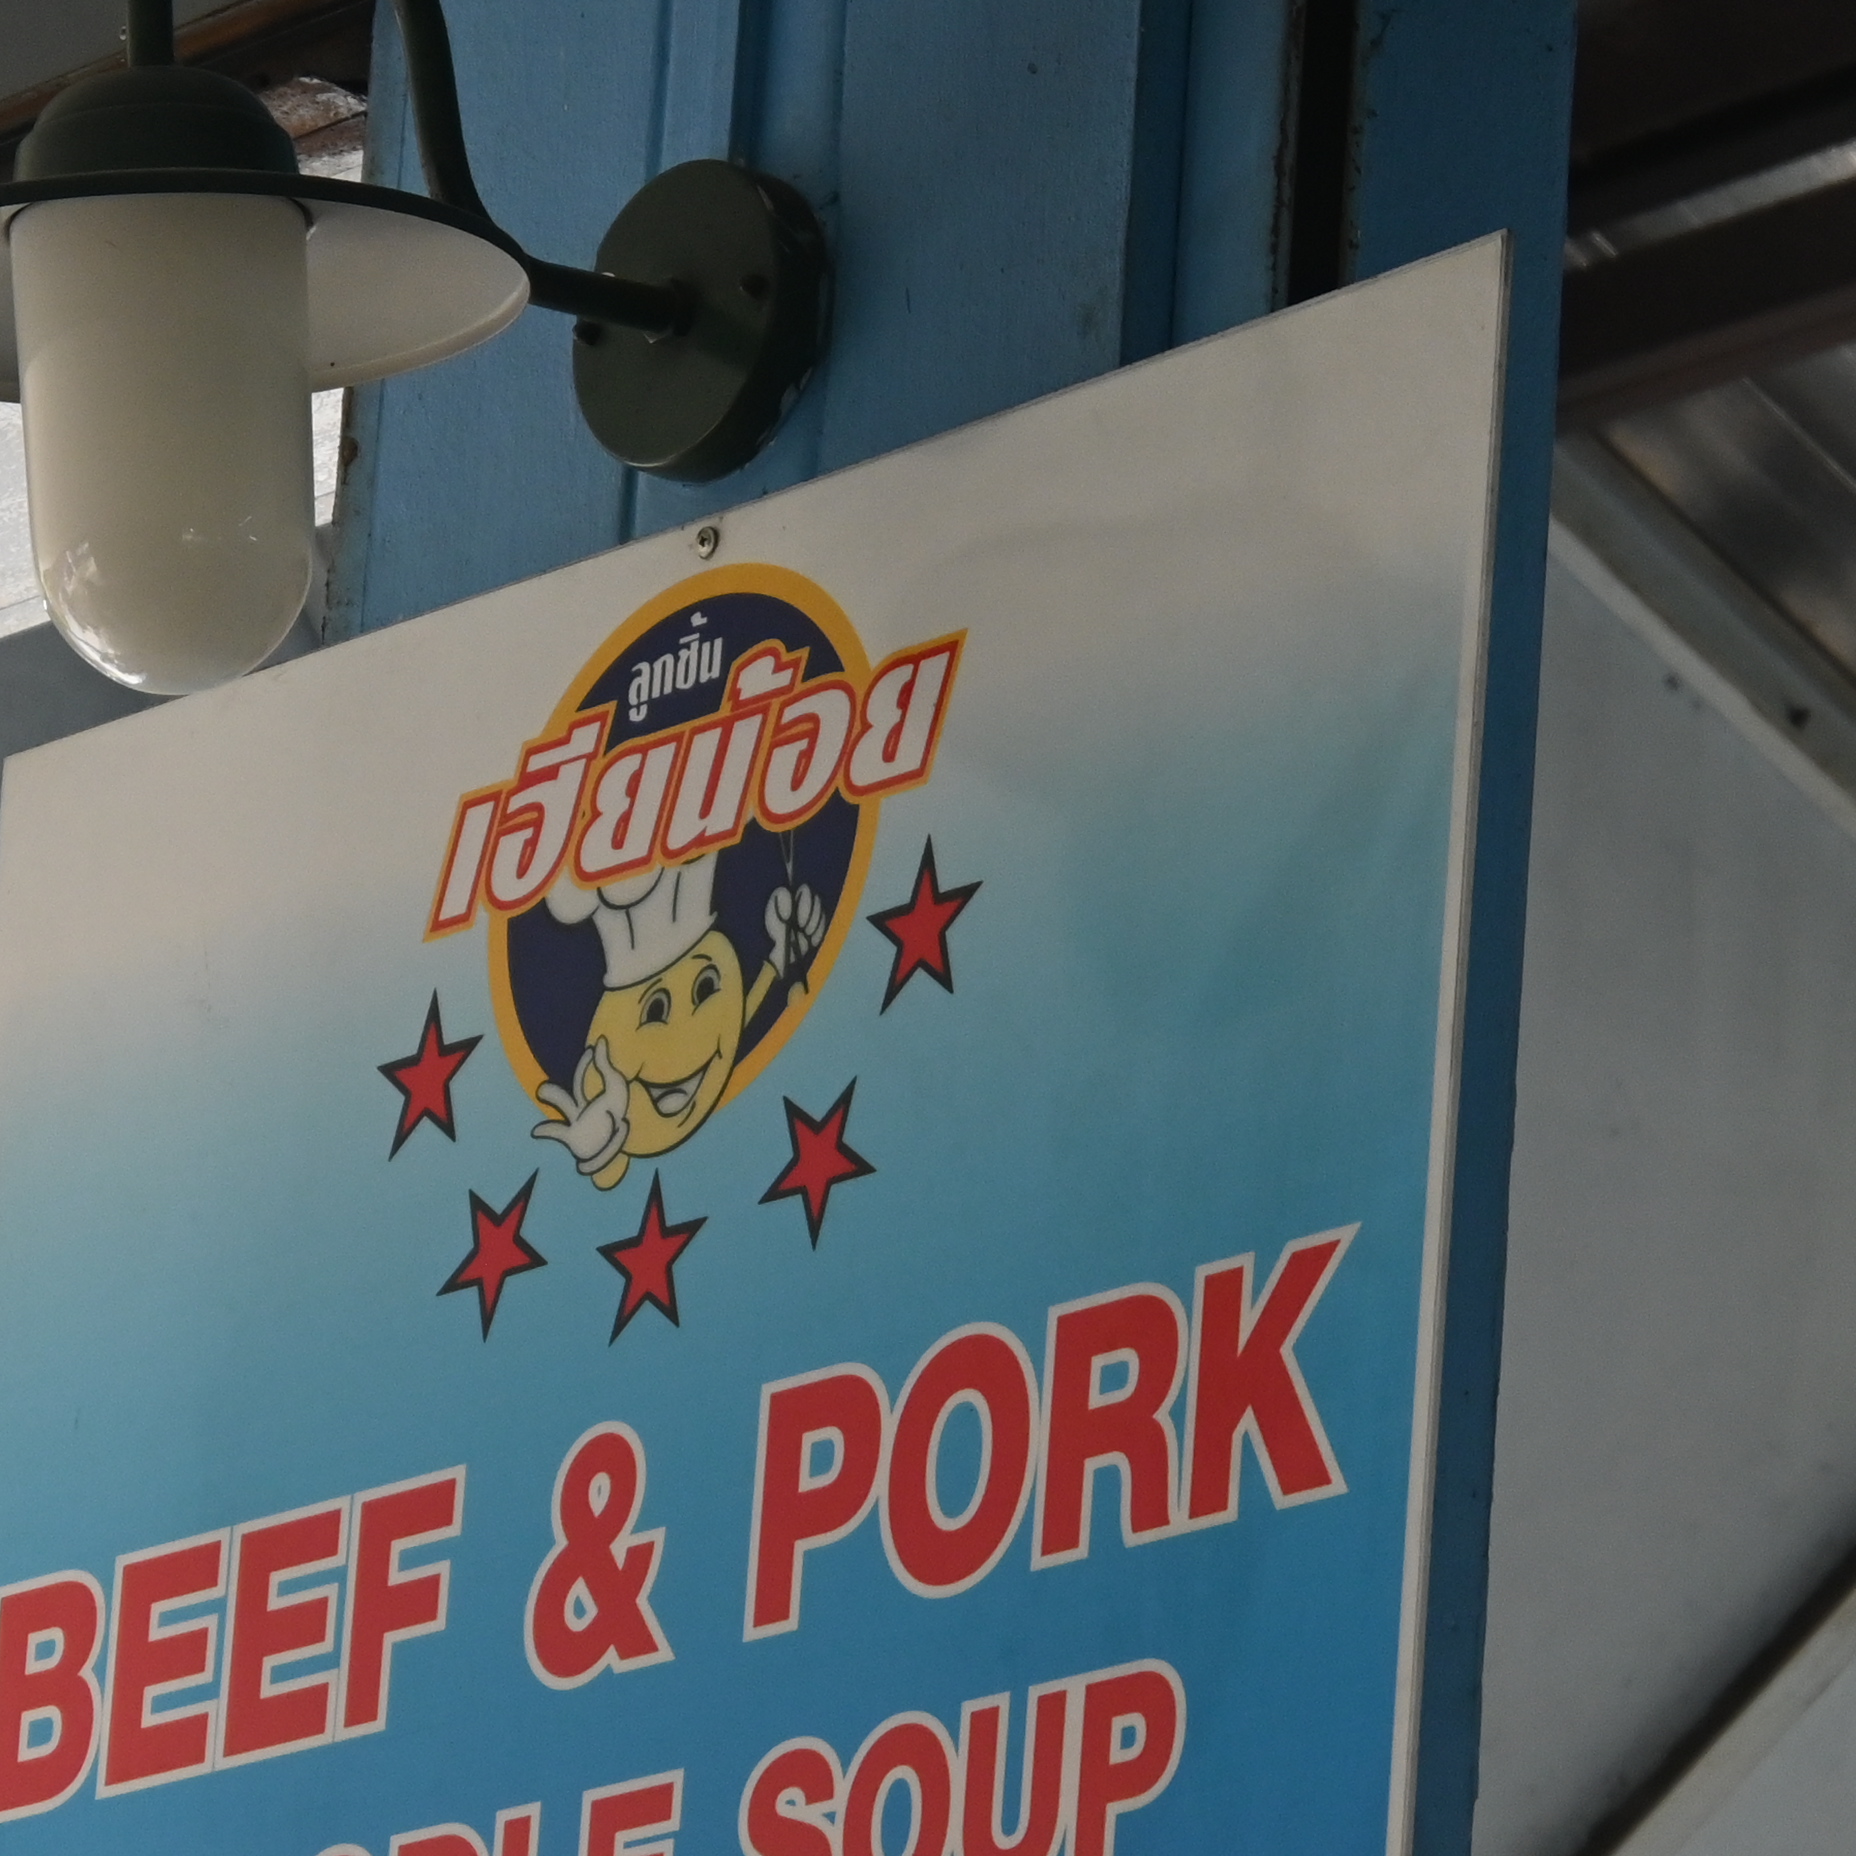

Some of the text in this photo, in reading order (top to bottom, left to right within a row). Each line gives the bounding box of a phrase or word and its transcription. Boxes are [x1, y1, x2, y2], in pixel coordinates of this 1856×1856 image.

[424, 634, 964, 940] เฮียน้อย
[628, 611, 723, 722] ลูกชิ้น
[524, 1422, 675, 1690] &
[744, 1223, 1361, 1641] PORK
